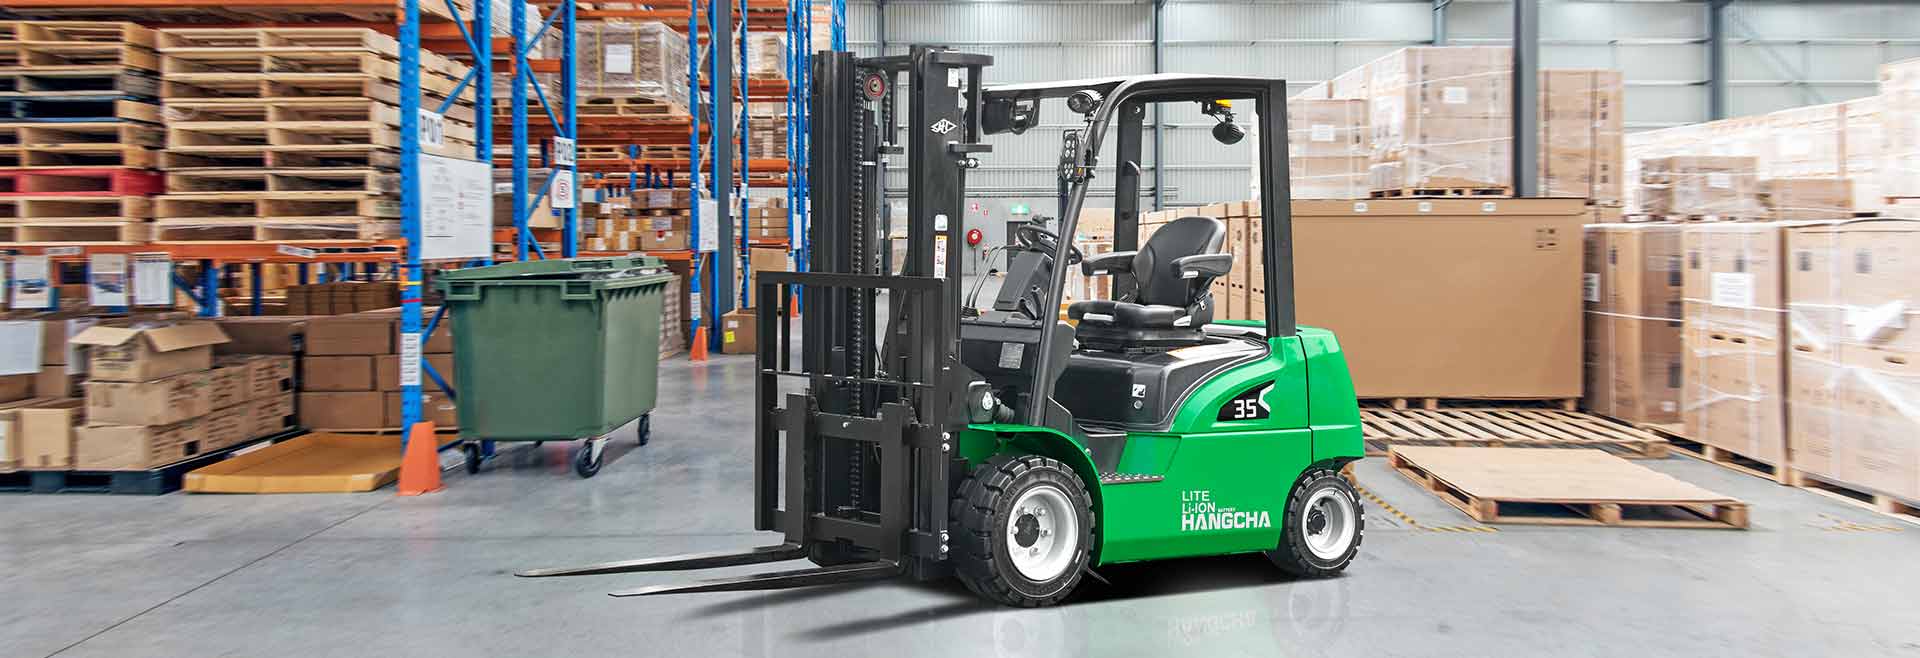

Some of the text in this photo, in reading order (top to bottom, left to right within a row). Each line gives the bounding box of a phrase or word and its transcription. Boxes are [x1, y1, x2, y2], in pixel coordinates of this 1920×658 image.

[1234, 398, 1257, 418] 35
[1182, 490, 1210, 502] LITE
[1182, 511, 1271, 531] HANGCHA
